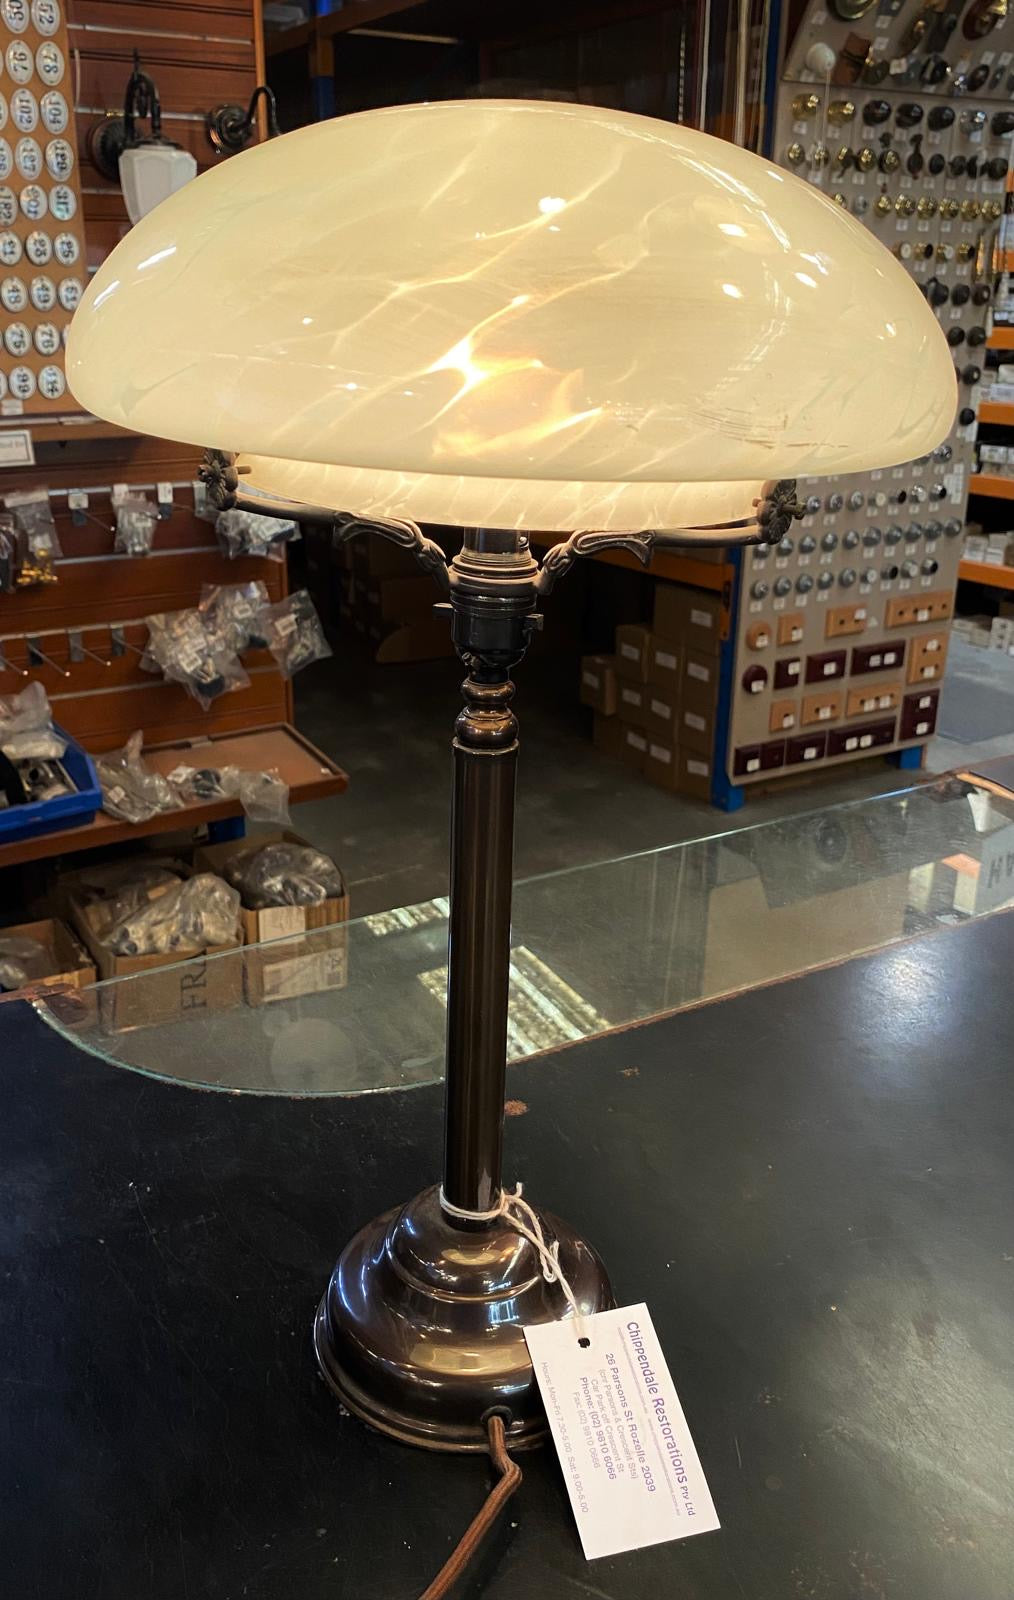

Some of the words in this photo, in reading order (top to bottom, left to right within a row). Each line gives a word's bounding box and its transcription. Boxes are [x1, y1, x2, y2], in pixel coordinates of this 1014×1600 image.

[39, 3, 54, 24] 52
[13, 51, 28, 72] 76
[43, 53, 58, 73] 78
[19, 98, 33, 124] 102
[48, 99, 62, 124] 104
[55, 189, 70, 218] 317
[605, 1353, 616, 1366] 26
[626, 1321, 659, 1394] Chippendale
[610, 1367, 629, 1408] Parsons
[591, 1379, 600, 1393] Car
[596, 1394, 606, 1413] Park
[605, 1425, 621, 1462] Crescent
[617, 1462, 625, 1473] St
[604, 1385, 618, 1415] Parsons
[617, 1425, 633, 1461] Crescent
[624, 1409, 634, 1421] St
[579, 1377, 595, 1409] Phone:
[589, 1411, 601, 1428] (02)
[596, 1430, 609, 1454] 9810
[603, 1455, 617, 1480] 6066
[652, 1396, 688, 1484] Restorations
[628, 1424, 646, 1464] Rozelle
[641, 1465, 656, 1492] 2039
[681, 1485, 691, 1500] Pty
[685, 1501, 697, 1516] Ltd
